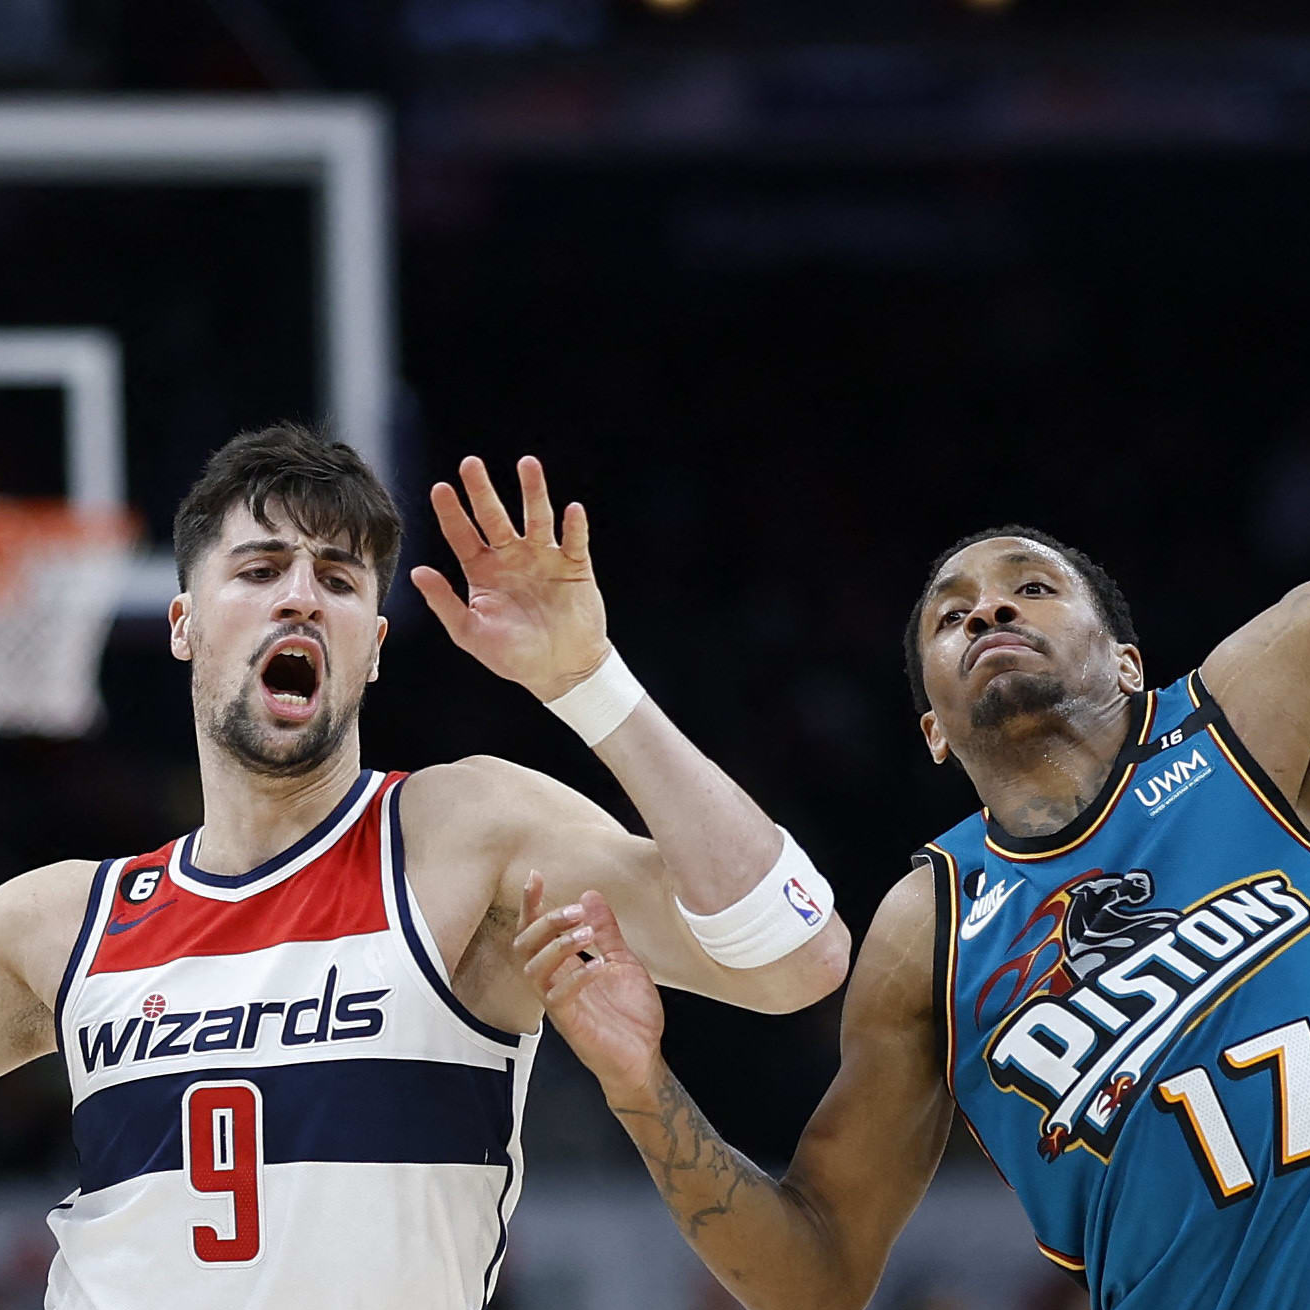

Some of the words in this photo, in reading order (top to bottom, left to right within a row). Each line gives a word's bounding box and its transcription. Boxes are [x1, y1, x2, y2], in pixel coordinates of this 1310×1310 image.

[1161, 728, 1183, 750] 16
[1134, 749, 1208, 807] UWM
[129, 870, 160, 901] 6
[969, 879, 1007, 923] NIKE
[77, 962, 394, 1074] wizards
[988, 877, 1310, 1108] PISTONS
[185, 1081, 264, 1266] 9
